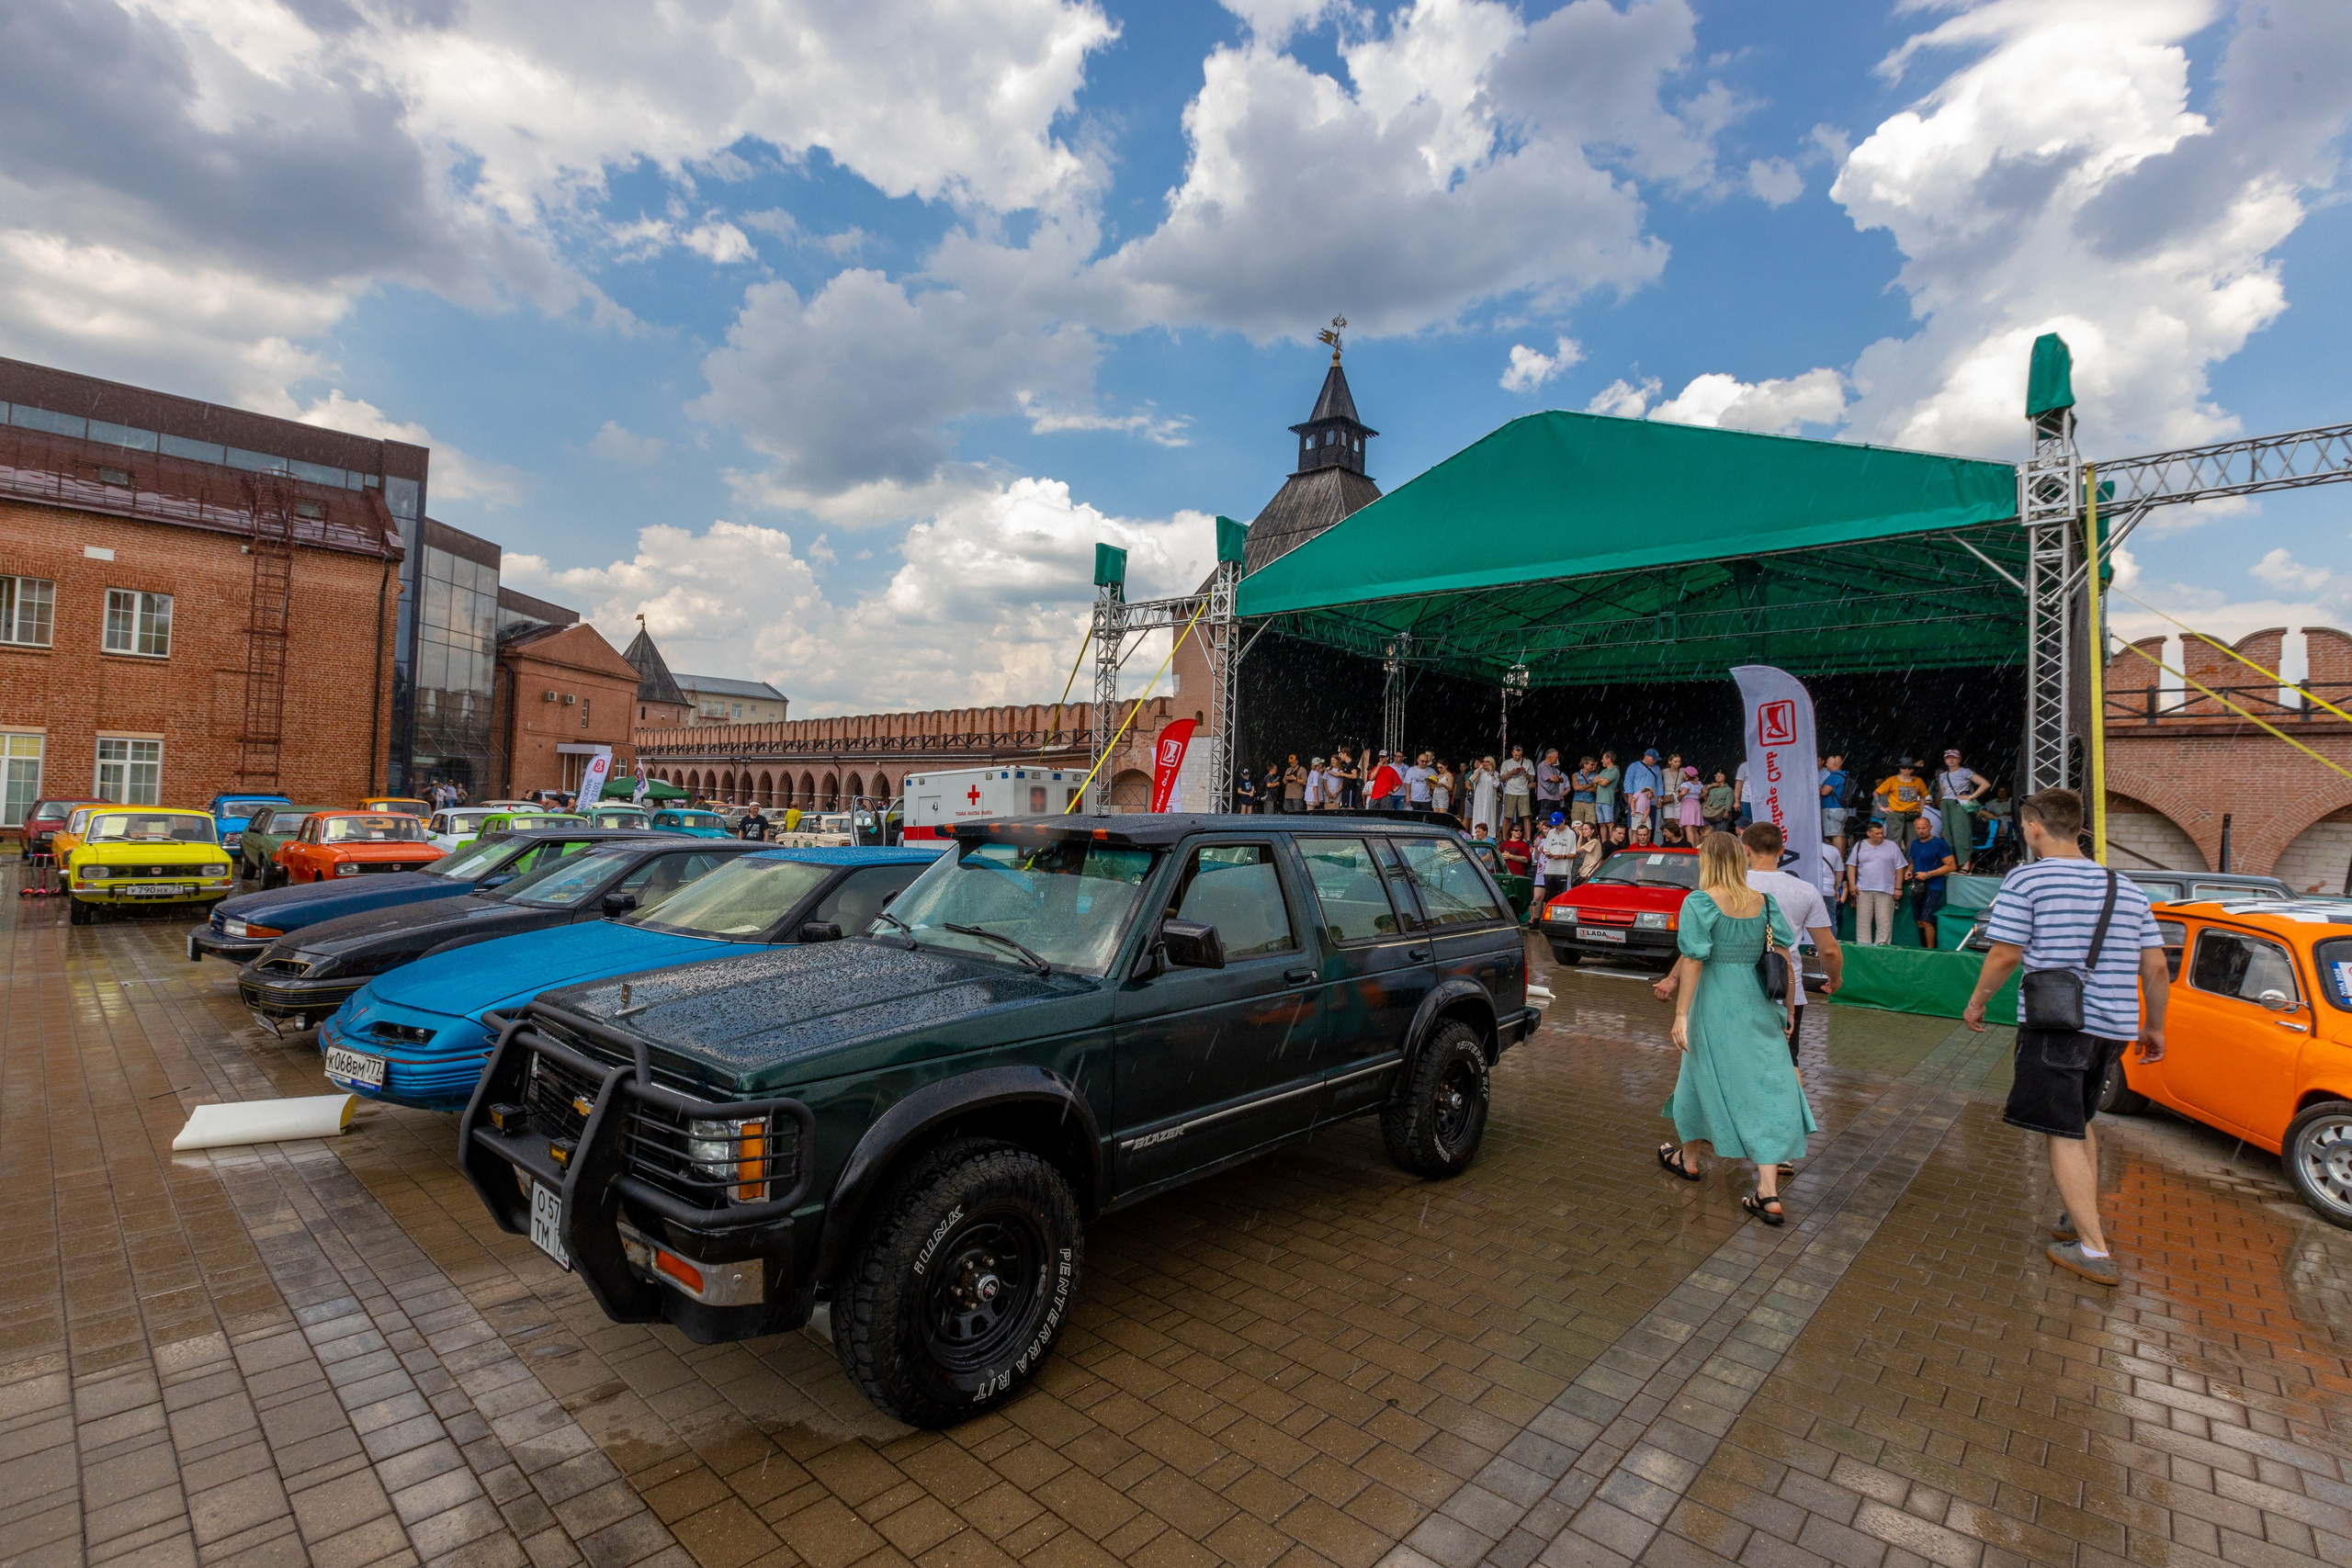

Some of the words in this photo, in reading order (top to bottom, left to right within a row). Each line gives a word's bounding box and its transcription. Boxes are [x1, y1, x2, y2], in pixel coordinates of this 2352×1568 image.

[1161, 769, 1171, 787] Club
[366, 1058, 382, 1076] 777
[1132, 1125, 1185, 1152] BLAZER
[1016, 1247, 1071, 1374] PENTERRA
[973, 1370, 1011, 1402] R/T
